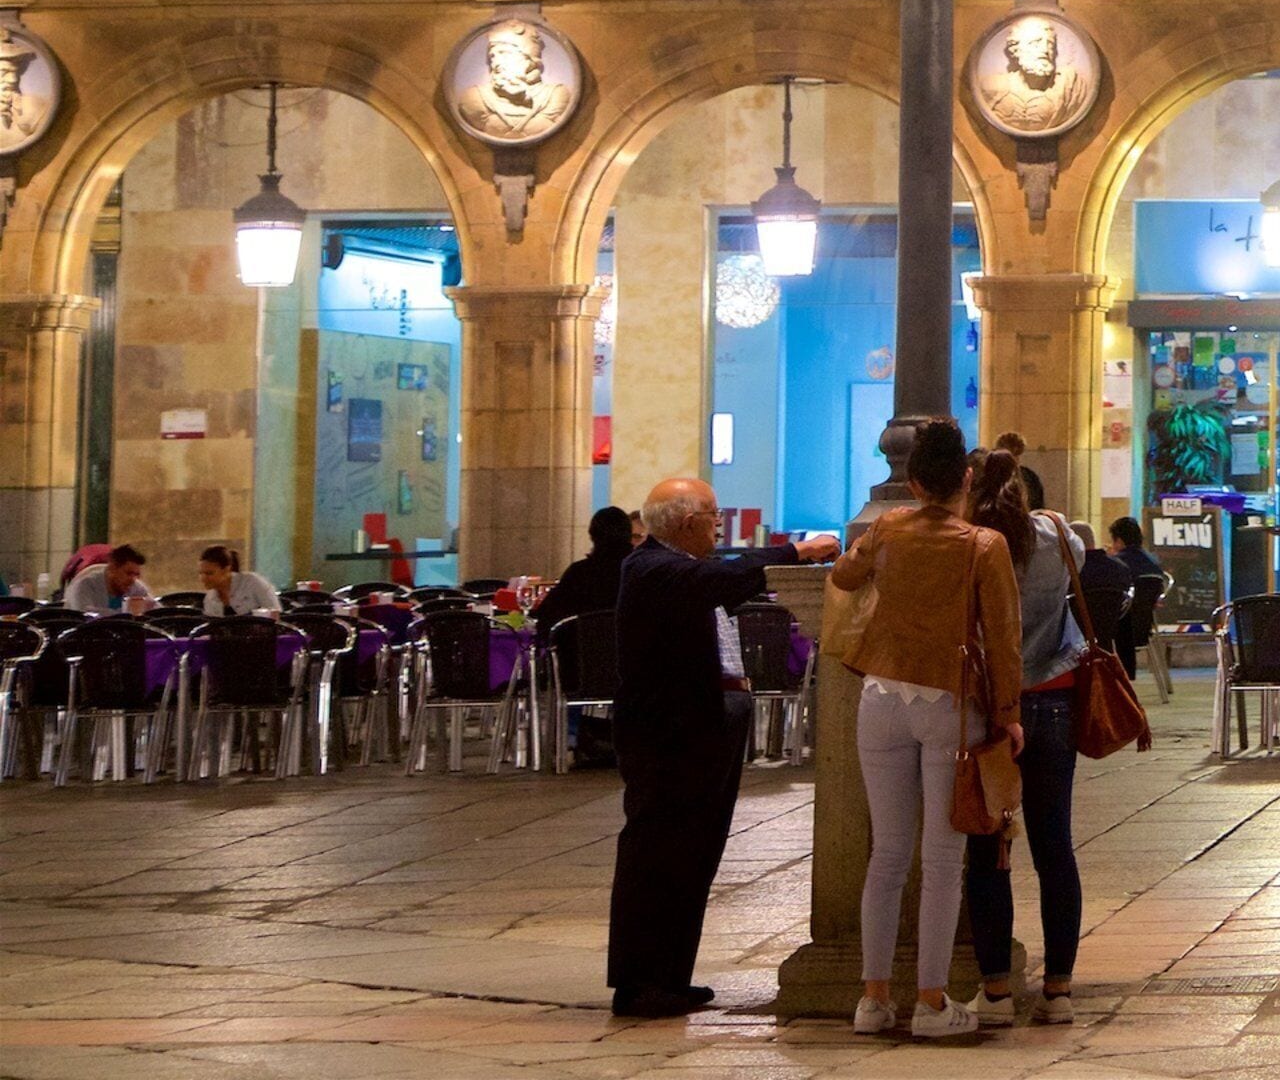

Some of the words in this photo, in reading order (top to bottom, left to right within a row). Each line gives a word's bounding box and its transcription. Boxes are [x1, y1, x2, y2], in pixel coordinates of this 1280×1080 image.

[1209, 208, 1227, 232] la
[1166, 500, 1197, 509] HALF
[1152, 514, 1212, 548] MENÚ
